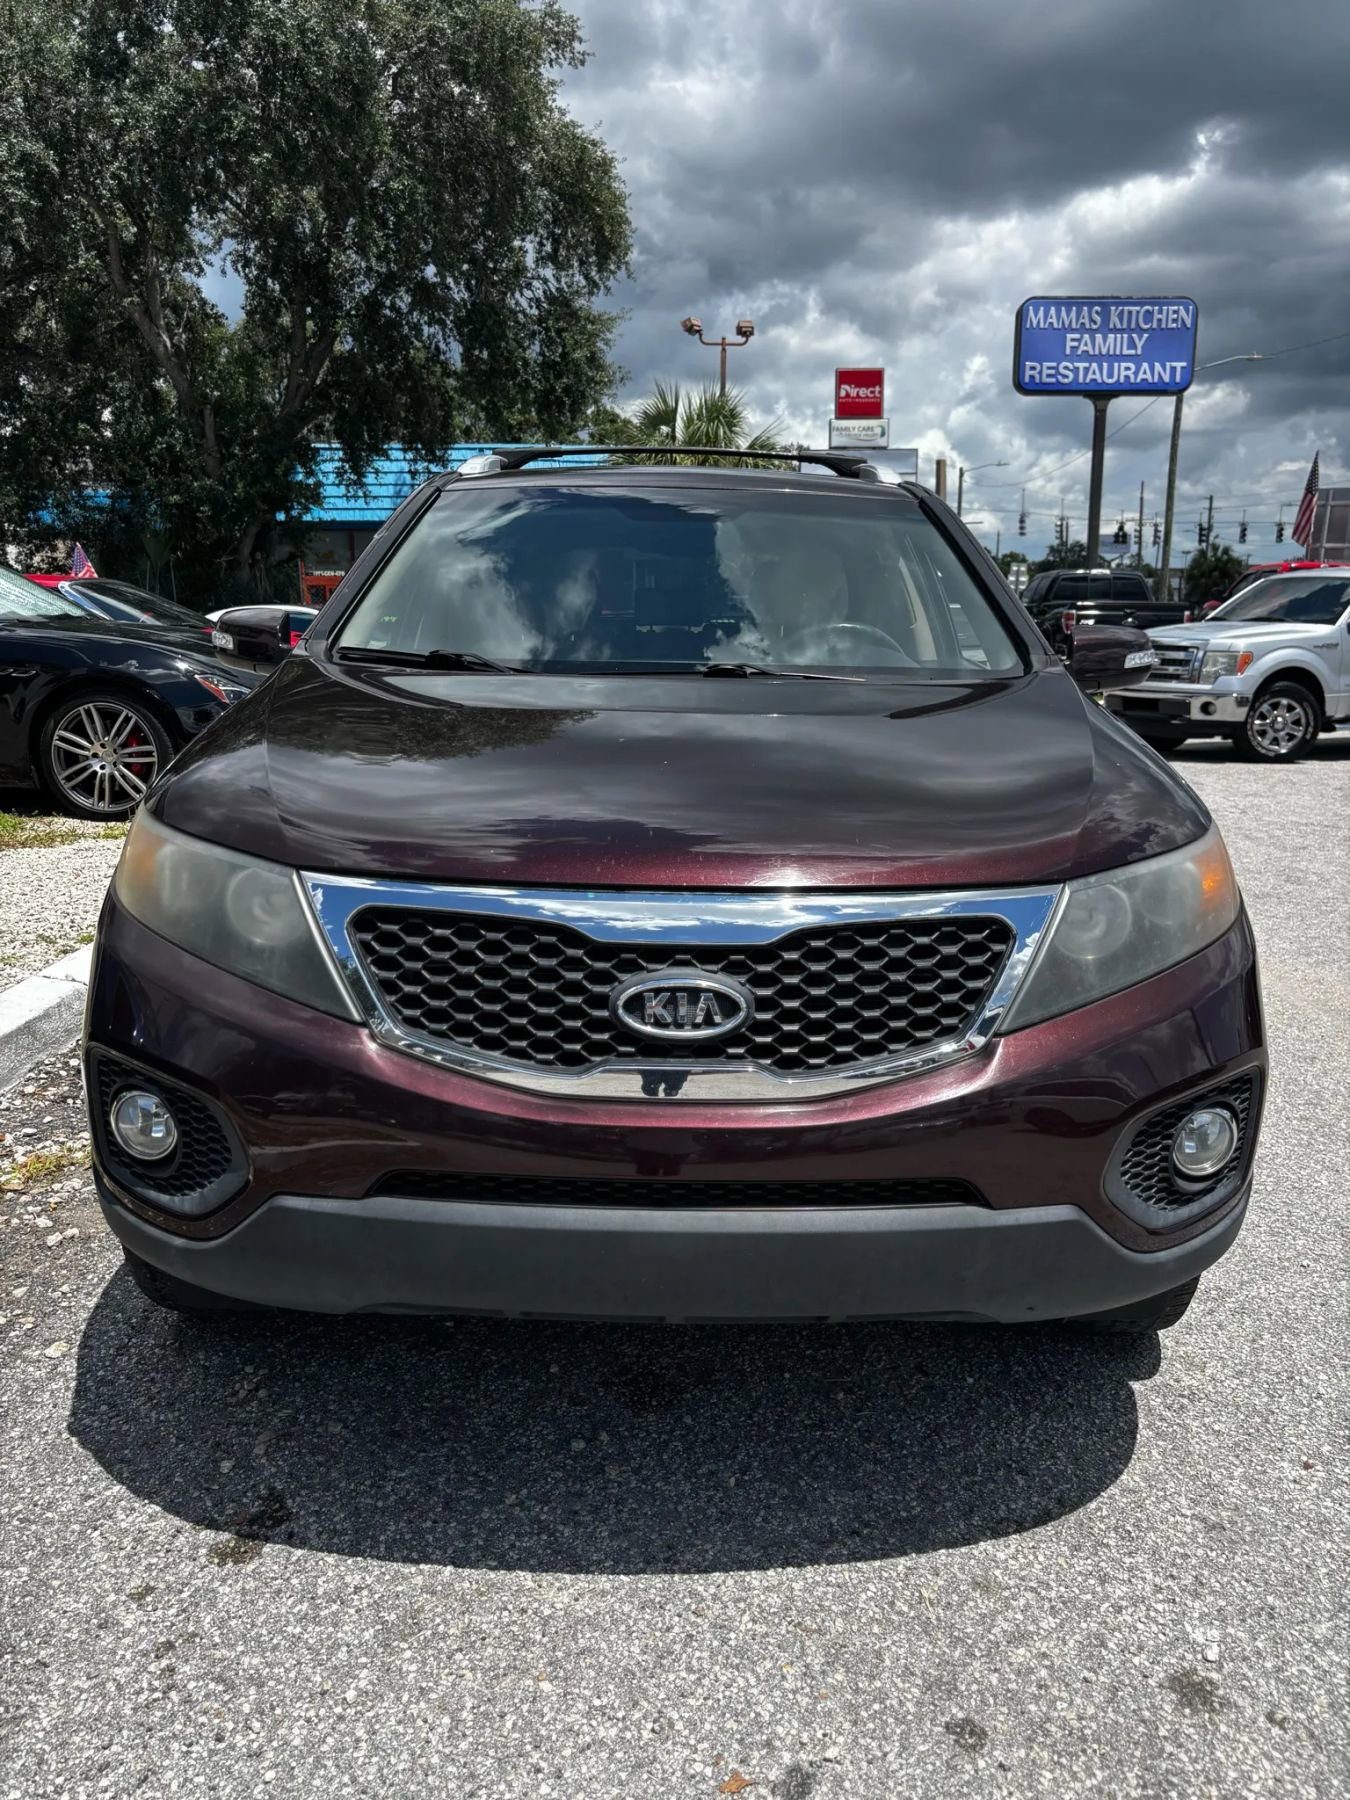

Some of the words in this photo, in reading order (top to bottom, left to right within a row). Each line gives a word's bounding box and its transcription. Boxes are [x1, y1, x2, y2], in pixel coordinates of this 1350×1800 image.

[1026, 305, 1101, 329] MAMAS
[1109, 305, 1193, 329] KITCHEN
[1065, 333, 1149, 356] FAMILY
[1024, 361, 1187, 384] RESTAURANT
[840, 384, 881, 397] Direct
[643, 992, 722, 1023] KIA
